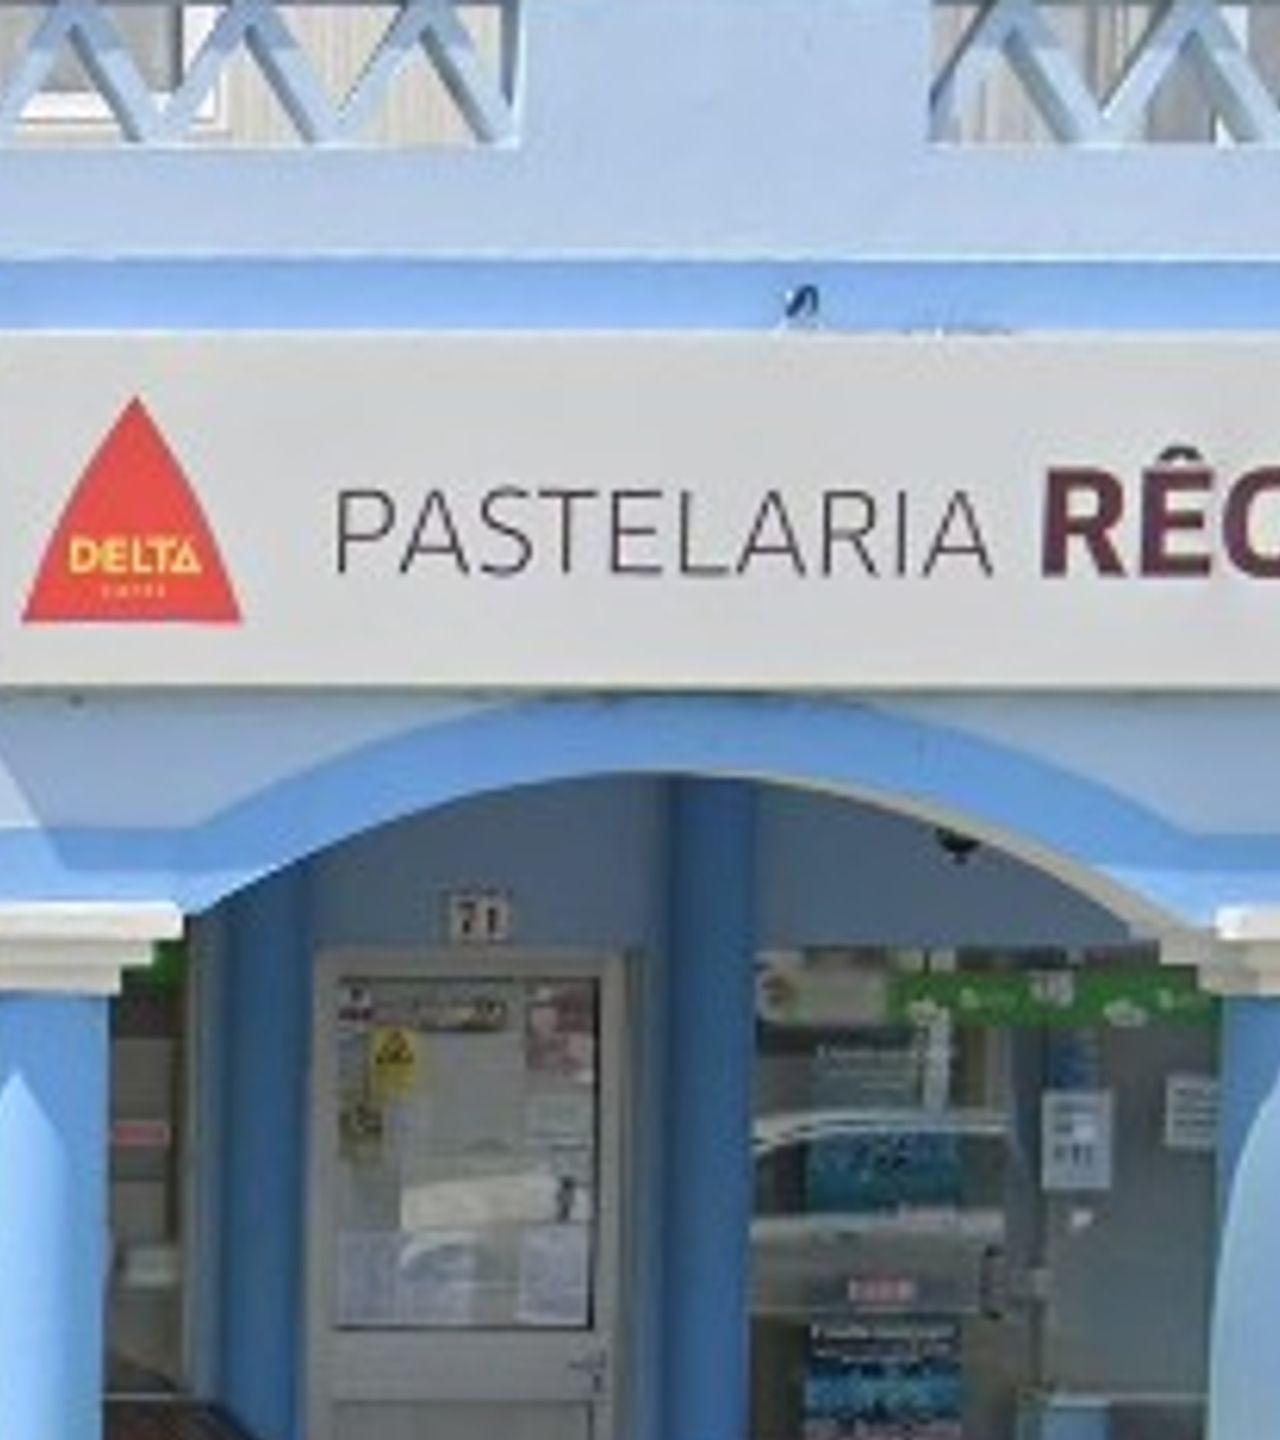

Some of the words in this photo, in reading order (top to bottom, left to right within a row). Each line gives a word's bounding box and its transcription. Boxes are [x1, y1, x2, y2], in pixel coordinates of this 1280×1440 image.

[336, 488, 995, 578] PASTELARIA
[69, 535, 203, 574] DELTA
[457, 900, 498, 936] 71
